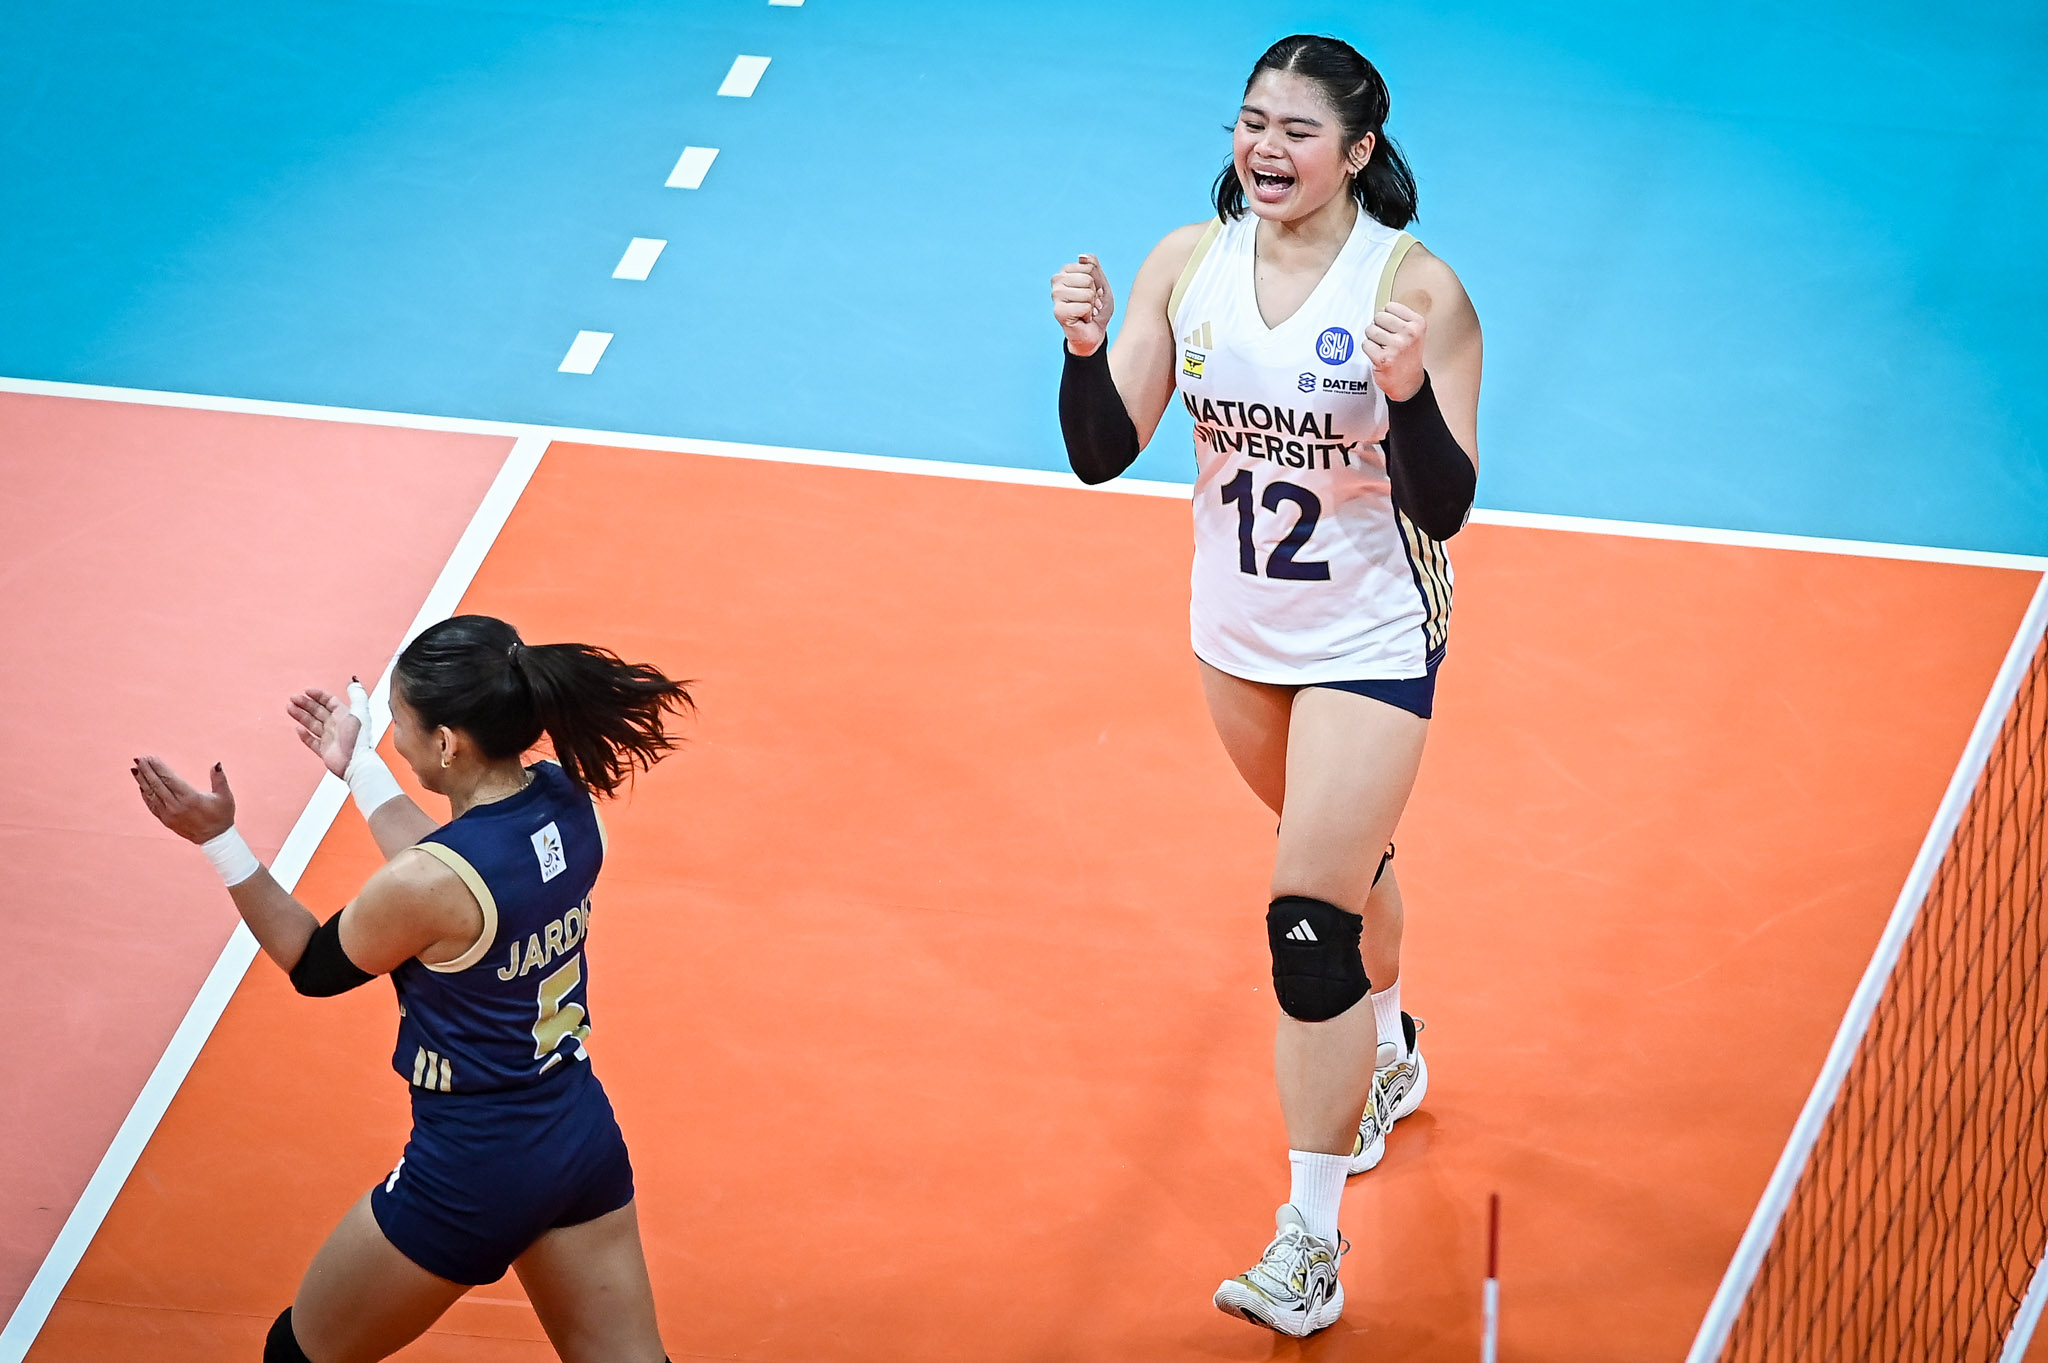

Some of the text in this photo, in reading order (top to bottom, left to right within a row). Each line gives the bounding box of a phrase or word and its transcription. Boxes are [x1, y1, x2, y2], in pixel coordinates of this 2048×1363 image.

[1318, 330, 1350, 362] SM
[1183, 391, 1344, 441] NATIONAL
[1322, 378, 1368, 391] DATEM
[1220, 468, 1332, 582] 12
[497, 889, 592, 982] JARDI
[532, 952, 592, 1075] 5
